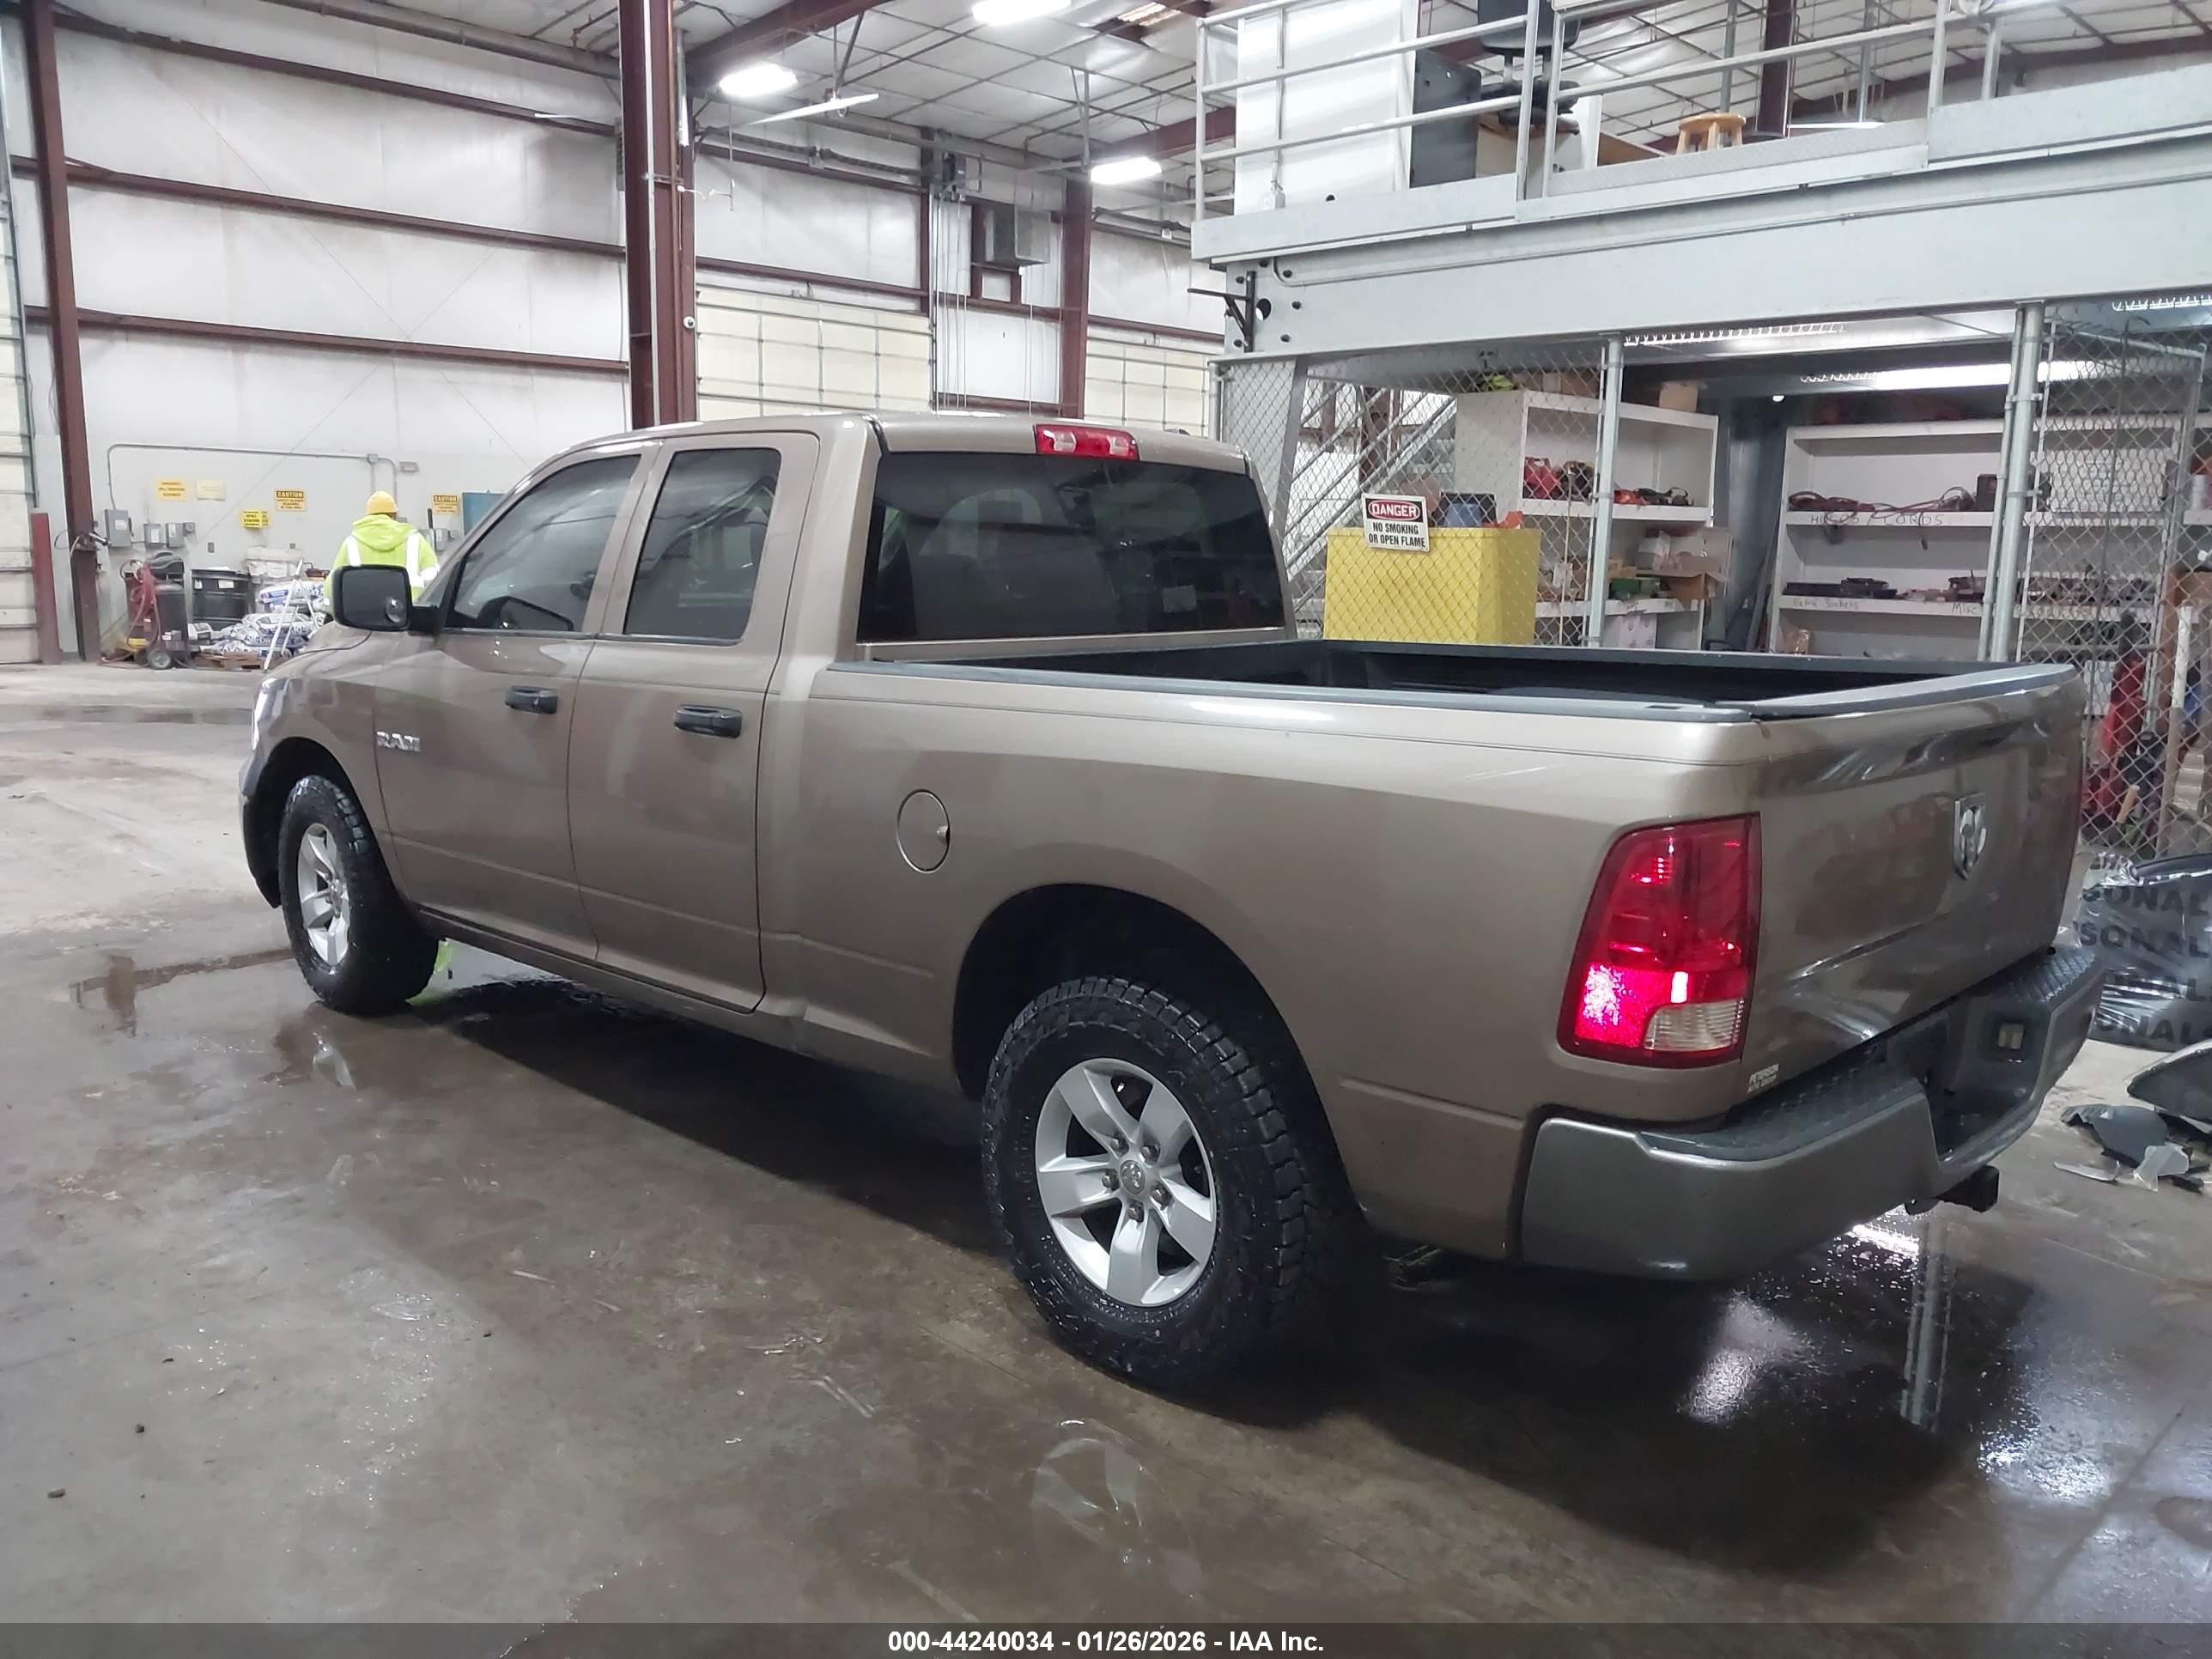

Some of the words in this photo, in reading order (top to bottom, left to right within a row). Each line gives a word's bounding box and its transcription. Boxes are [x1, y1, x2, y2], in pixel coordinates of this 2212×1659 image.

[1371, 503, 1417, 518] DANGER
[1373, 521, 1383, 532] NO
[1385, 523, 1419, 535] SMOKING
[1369, 533, 1379, 544] OR
[1380, 535, 1400, 546] OPEN
[1401, 537, 1426, 548] FLAME
[376, 732, 421, 752] RAM
